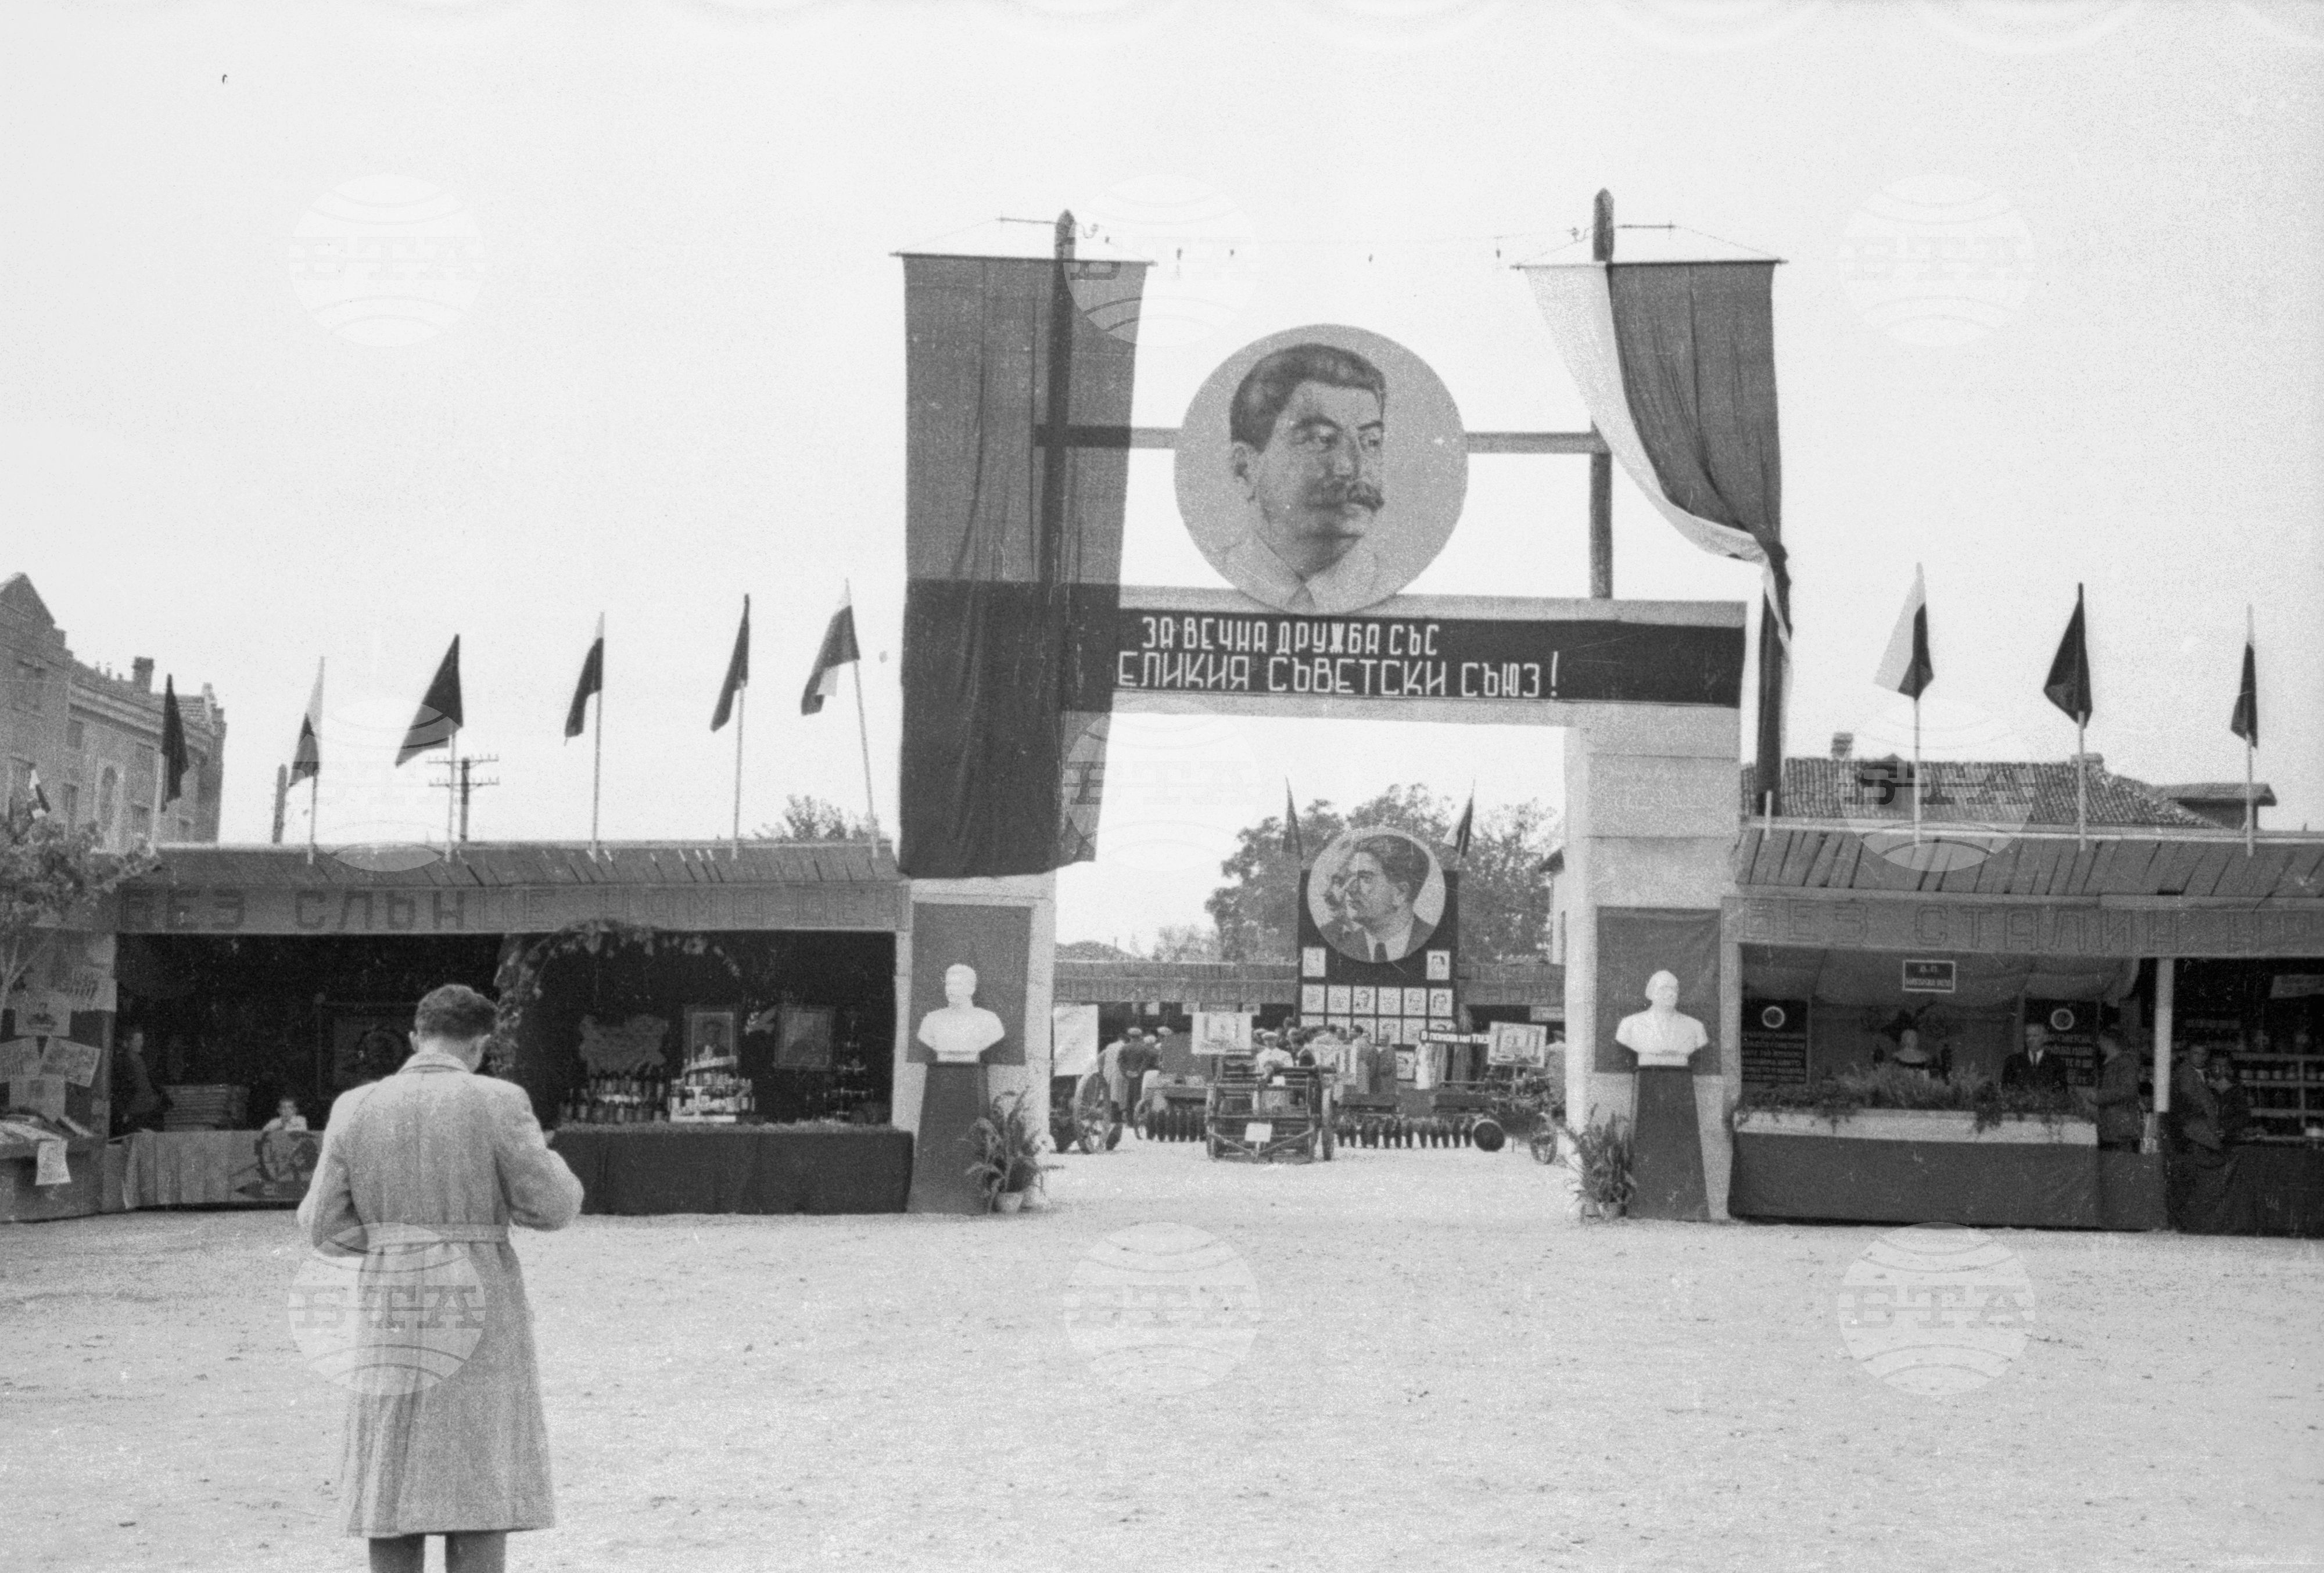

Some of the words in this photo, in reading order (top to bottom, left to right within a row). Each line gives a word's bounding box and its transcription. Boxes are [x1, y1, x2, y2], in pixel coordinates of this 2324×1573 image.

[1142, 616, 1174, 649] ЗА
[1183, 617, 1268, 653] ВЕЧНА
[1276, 621, 1380, 655] ДРУЖБА
[1389, 624, 1440, 656] СЪС
[1117, 651, 1250, 691] ЕЛИКИЯ
[1268, 656, 1447, 696] СЪВЕТСКИ
[1461, 651, 1558, 697] СЪЮЗ!
[1914, 904, 2180, 953] СТАЛИН
